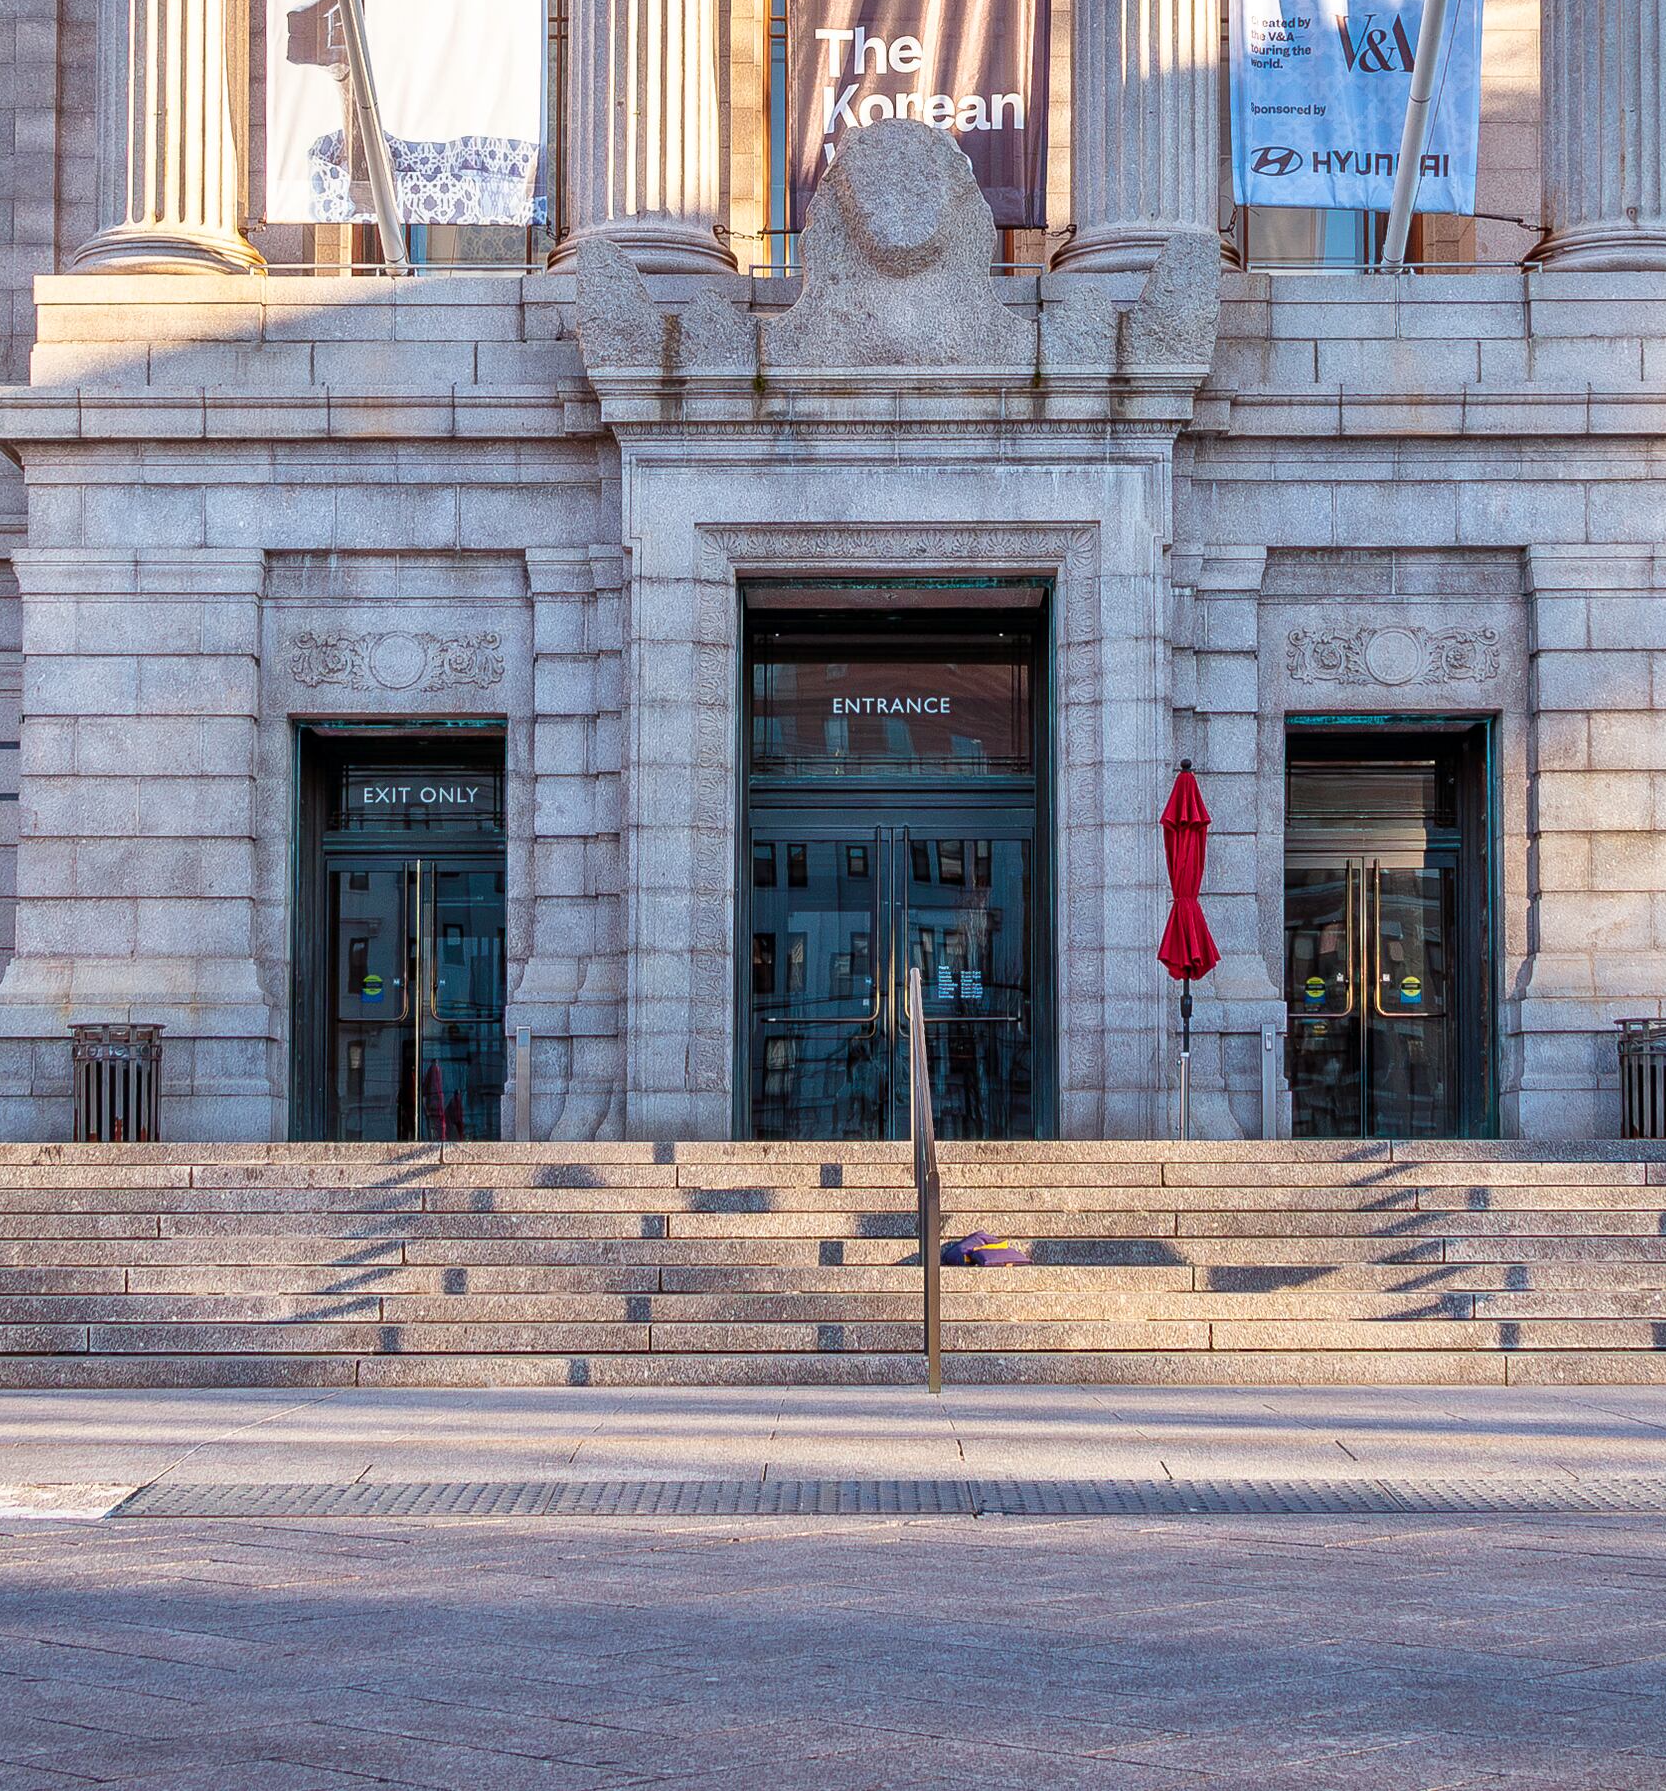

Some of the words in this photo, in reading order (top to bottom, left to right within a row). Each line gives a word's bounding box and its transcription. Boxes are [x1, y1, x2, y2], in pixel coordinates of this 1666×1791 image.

[1251, 15, 1295, 28] Ceated
[1297, 16, 1311, 29] by
[814, 25, 923, 78] The
[1251, 44, 1290, 58] touring
[1292, 44, 1312, 56] the
[1335, 12, 1416, 74] V&A
[822, 82, 1025, 134] Korean
[1313, 104, 1326, 117] by
[1312, 149, 1449, 178] HYUNAI
[832, 696, 951, 714] ENTRANCE
[363, 786, 411, 804] EXIT
[419, 786, 479, 804] ONLY
